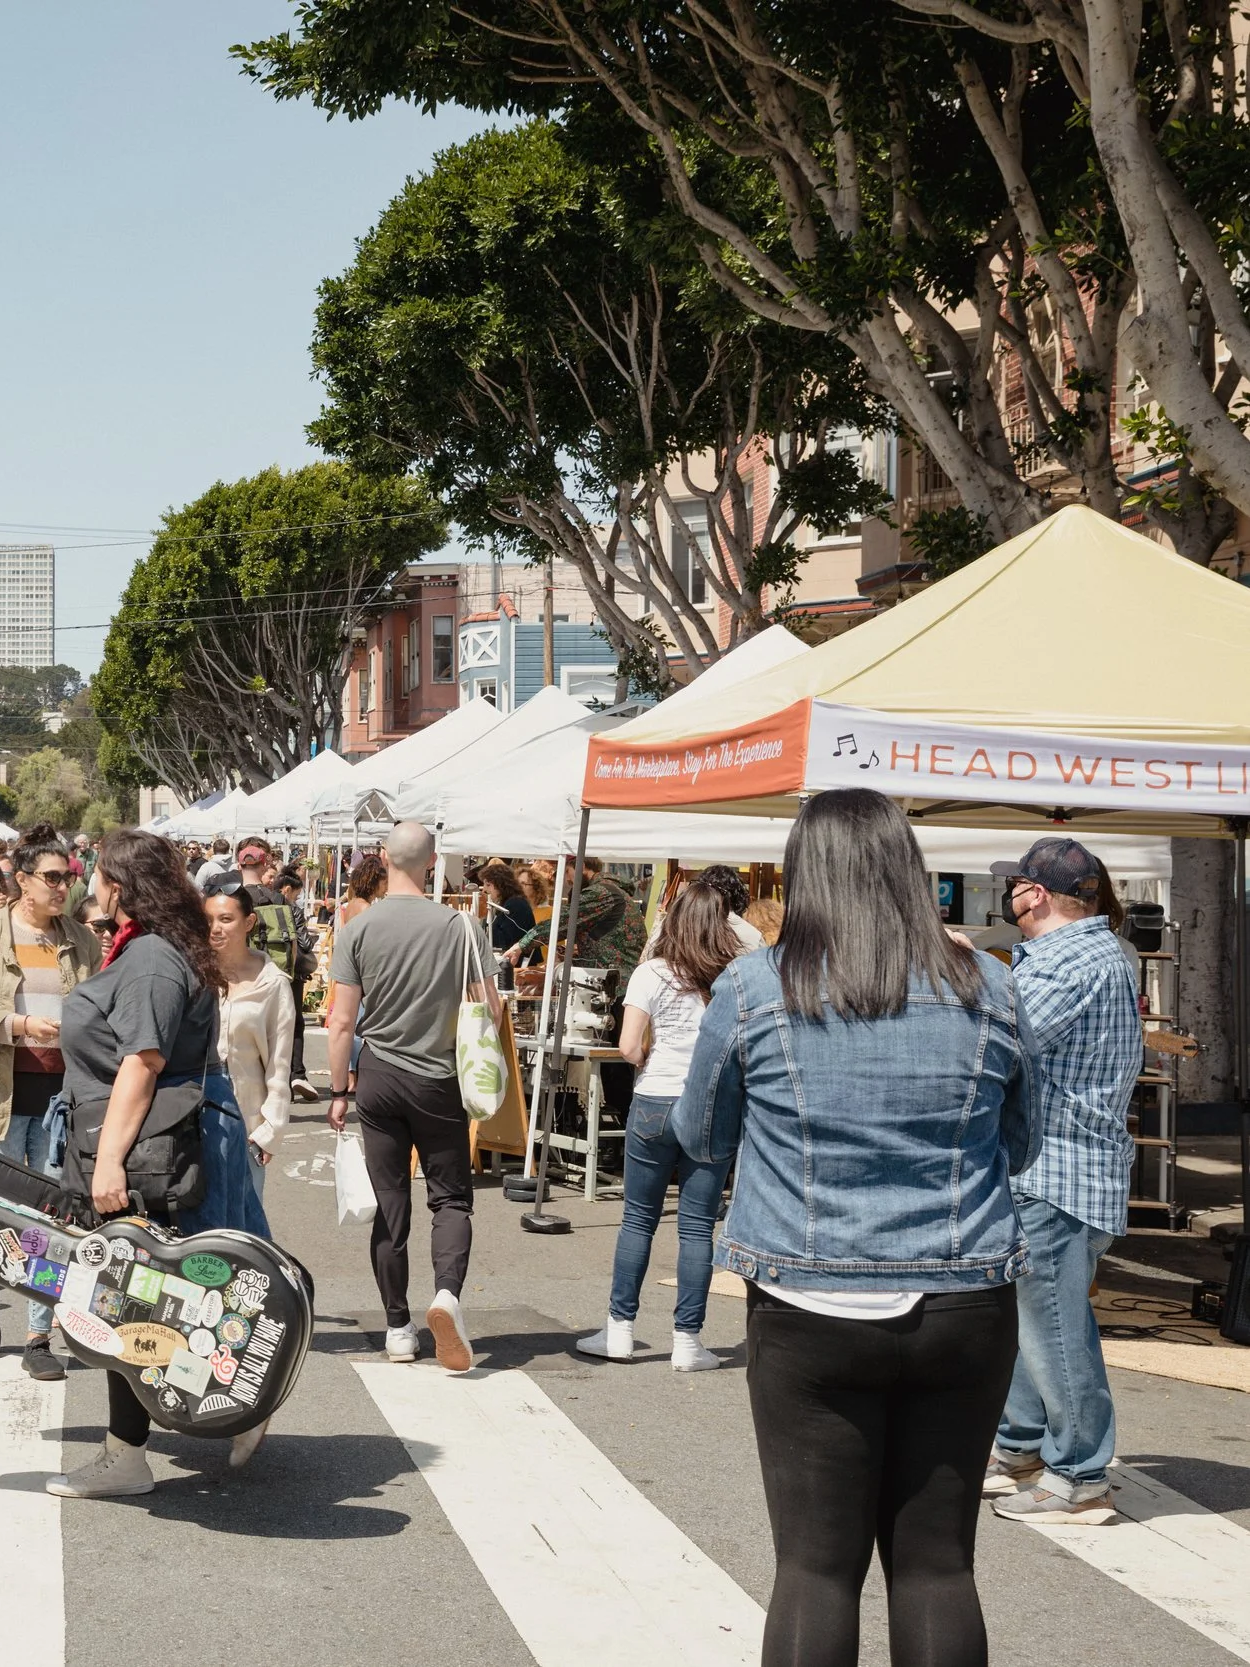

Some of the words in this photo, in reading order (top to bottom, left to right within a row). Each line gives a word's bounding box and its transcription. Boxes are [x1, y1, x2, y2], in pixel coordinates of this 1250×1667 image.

[594, 756, 611, 778] Come
[612, 755, 623, 779] For
[624, 755, 636, 778] The
[682, 750, 703, 785] Stay
[703, 746, 718, 770] For
[718, 742, 734, 768] The
[734, 739, 783, 772] Experience
[890, 740, 1038, 782] HEAD
[1054, 753, 1203, 790] WEST
[190, 1256, 223, 1270] BARBER
[56, 1269, 66, 1286] KIDS
[205, 1294, 215, 1323] SEEDSTORE
[119, 1325, 176, 1342] GarageMaHall
[253, 1314, 284, 1344] HAVE
[246, 1335, 276, 1360] YOU
[236, 1369, 263, 1386] IS
[241, 1354, 270, 1377] ALL
[229, 1376, 259, 1405] NOW
